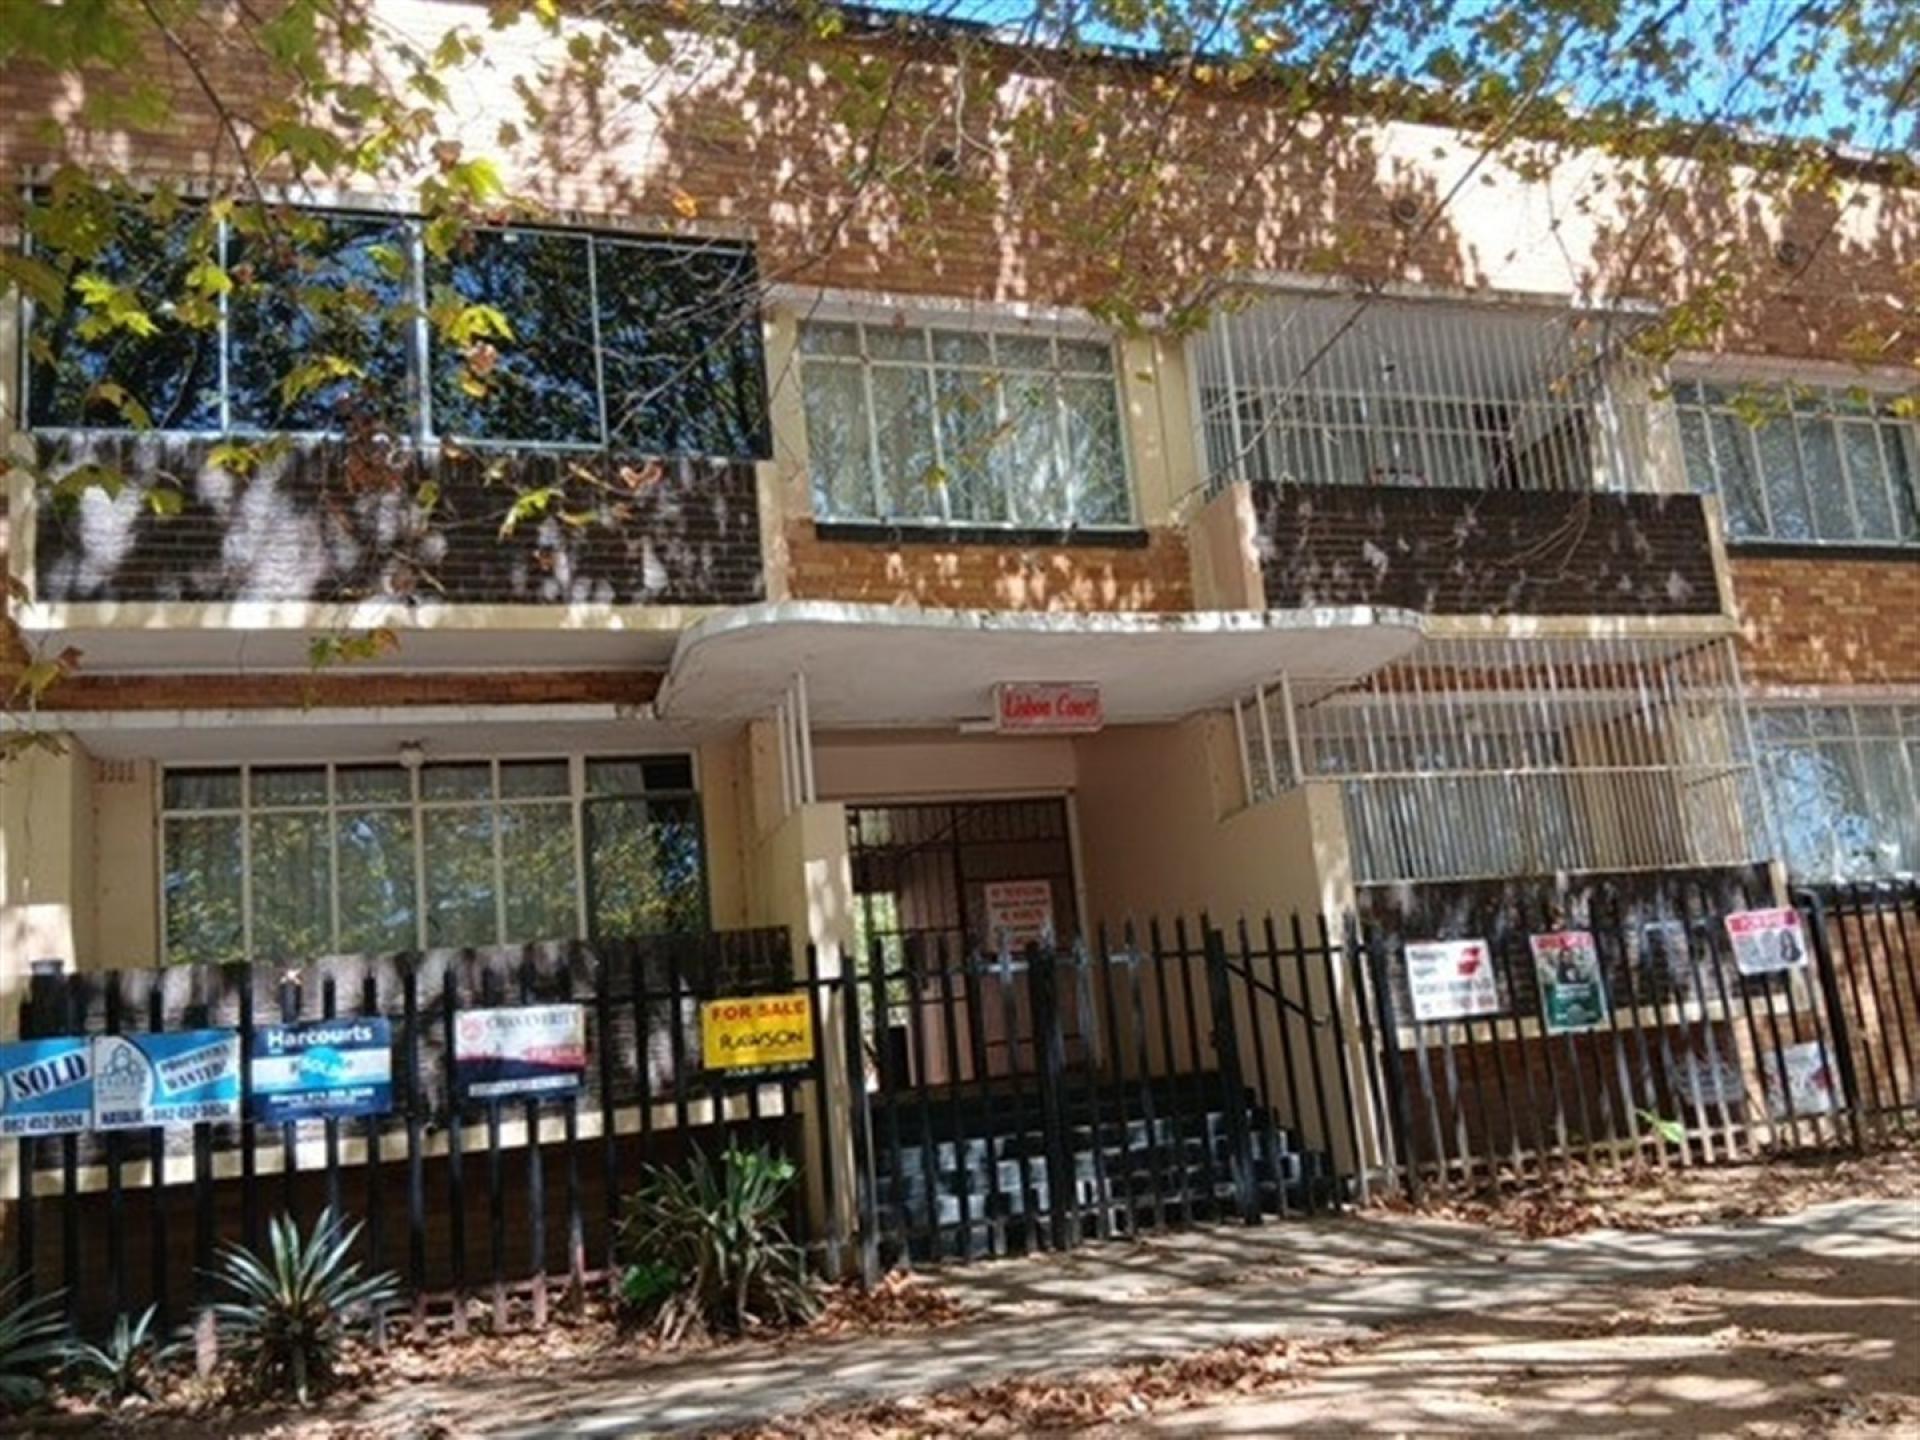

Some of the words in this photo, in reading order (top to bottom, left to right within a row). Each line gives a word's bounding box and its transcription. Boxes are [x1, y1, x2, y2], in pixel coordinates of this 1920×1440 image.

[711, 1003, 752, 1021] FOR
[758, 1000, 806, 1017] SALE
[267, 1025, 373, 1050] Harcourts
[719, 1030, 804, 1050] RAWSON
[12, 1053, 86, 1098] SOLD
